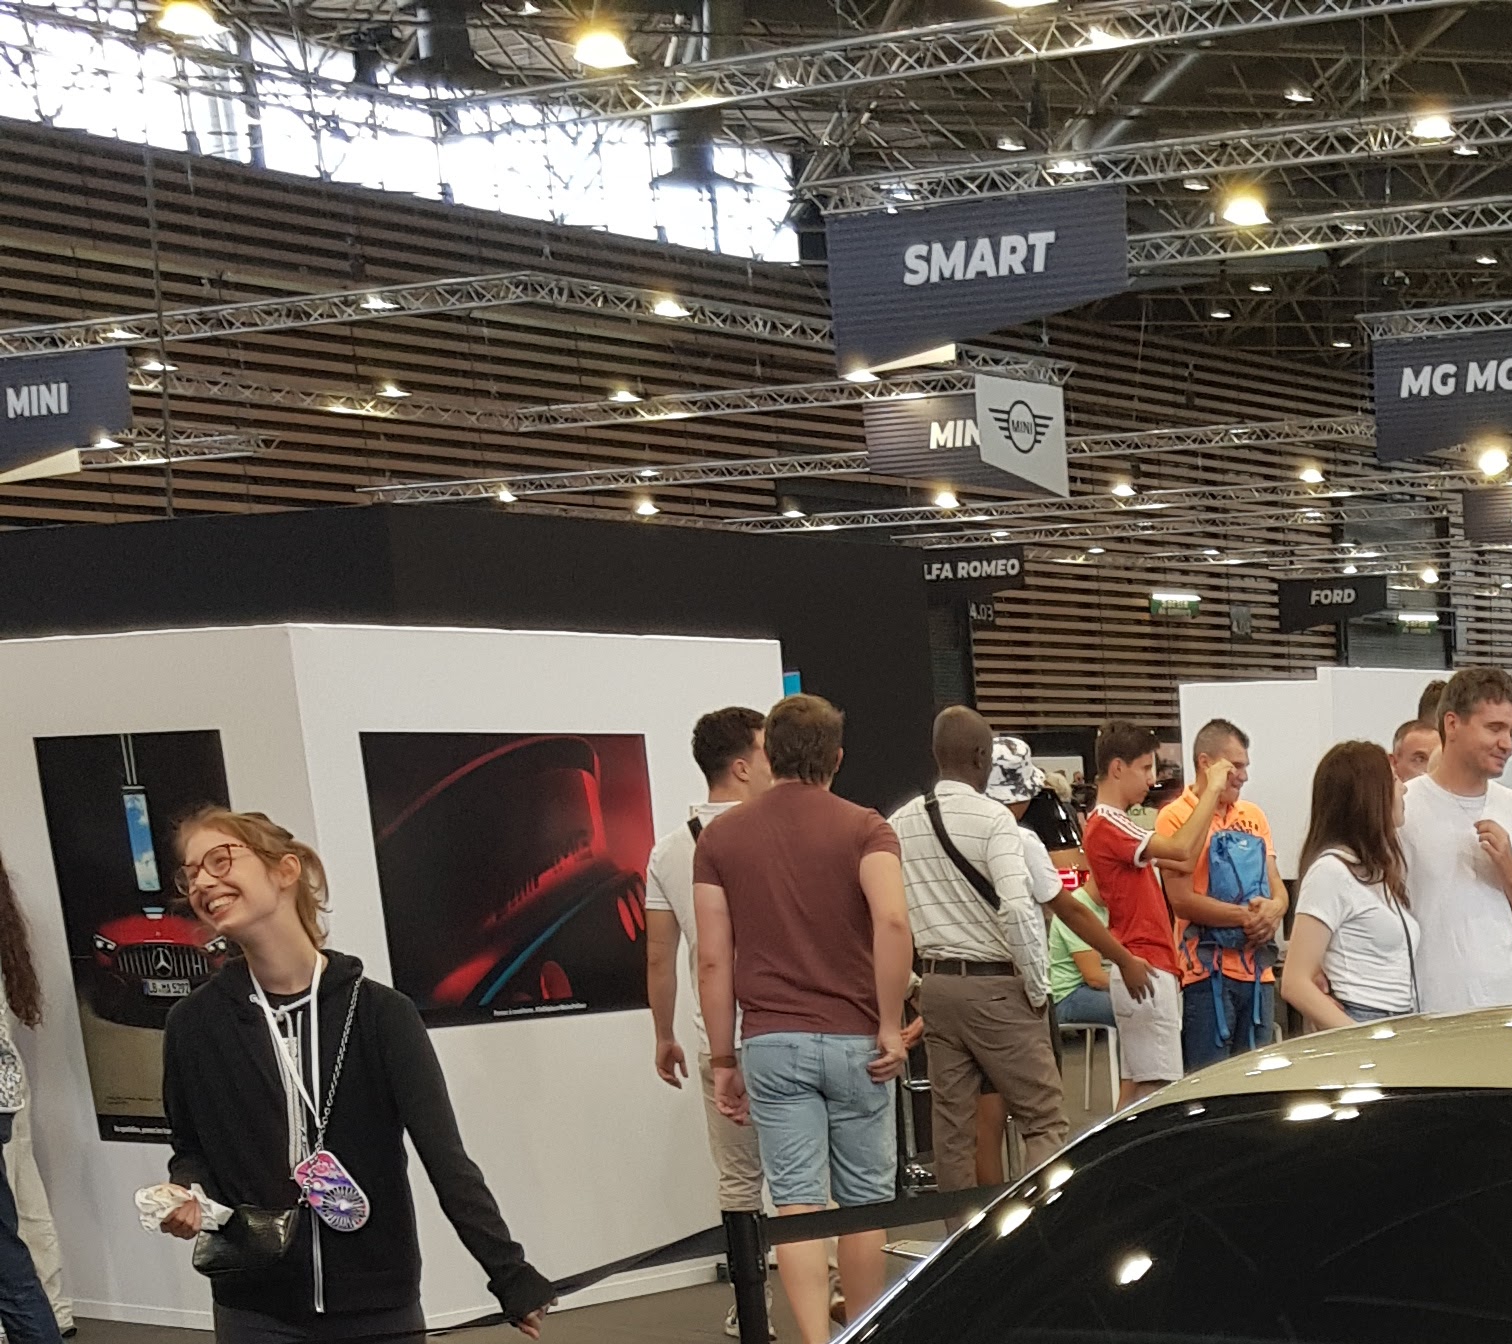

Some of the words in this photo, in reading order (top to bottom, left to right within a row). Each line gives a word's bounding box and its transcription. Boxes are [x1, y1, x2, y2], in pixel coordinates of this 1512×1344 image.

[902, 230, 1057, 286] SMART
[1400, 364, 1457, 399] MG
[6, 382, 69, 419] MINI
[1011, 419, 1033, 435] MINI
[957, 558, 1020, 578] ROMEO
[1310, 588, 1356, 605] FORD
